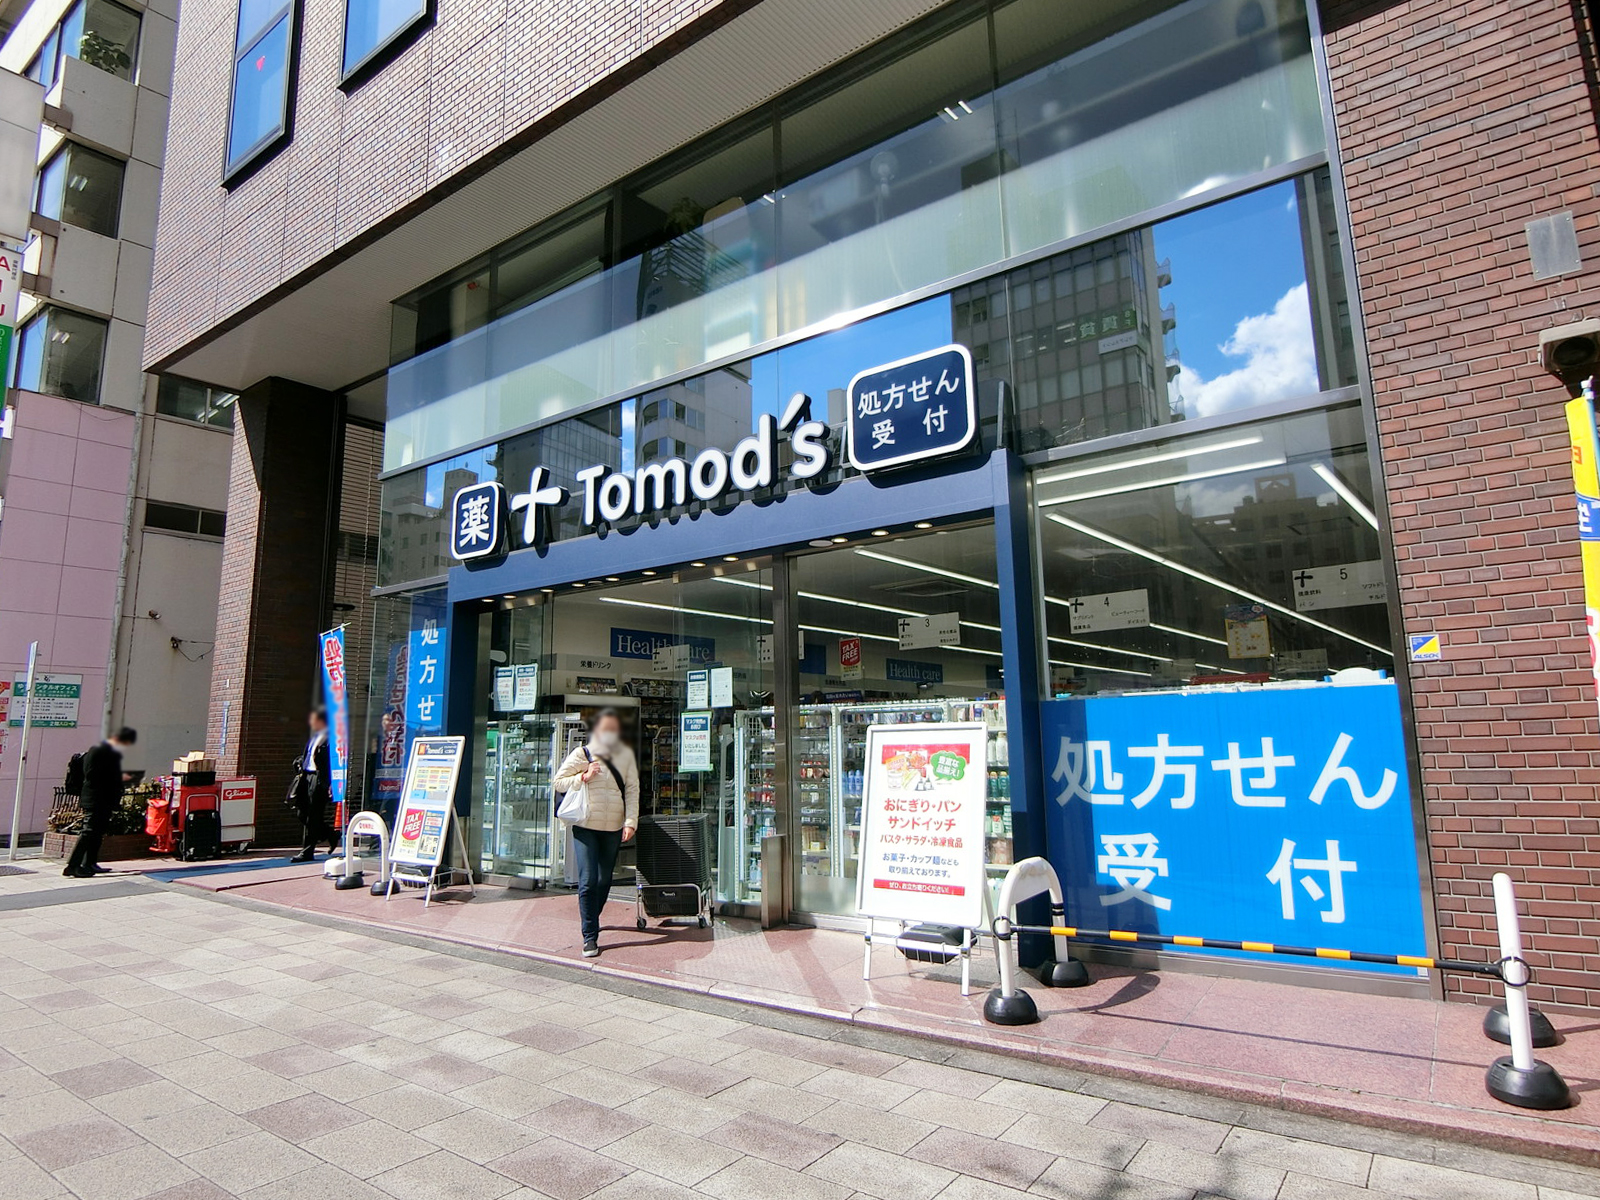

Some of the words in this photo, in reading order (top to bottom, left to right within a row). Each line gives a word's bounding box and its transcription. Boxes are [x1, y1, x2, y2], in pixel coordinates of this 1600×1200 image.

[857, 369, 960, 419] 処方せん
[577, 392, 830, 526] Tomod's
[459, 496, 491, 547] 薬
[1339, 568, 1349, 580] 5
[1103, 596, 1110, 607] 4
[924, 618, 931, 628] 3
[842, 642, 855, 653] TAX
[842, 648, 858, 662] FREE
[889, 663, 920, 679] Health
[921, 668, 941, 681] care
[1051, 732, 1398, 810] 処方せん
[225, 788, 252, 800] Glico
[883, 798, 962, 813] おにぎり・パン
[406, 812, 421, 824] TAX
[888, 815, 956, 832] サンドイッチ
[403, 820, 421, 834] FREE
